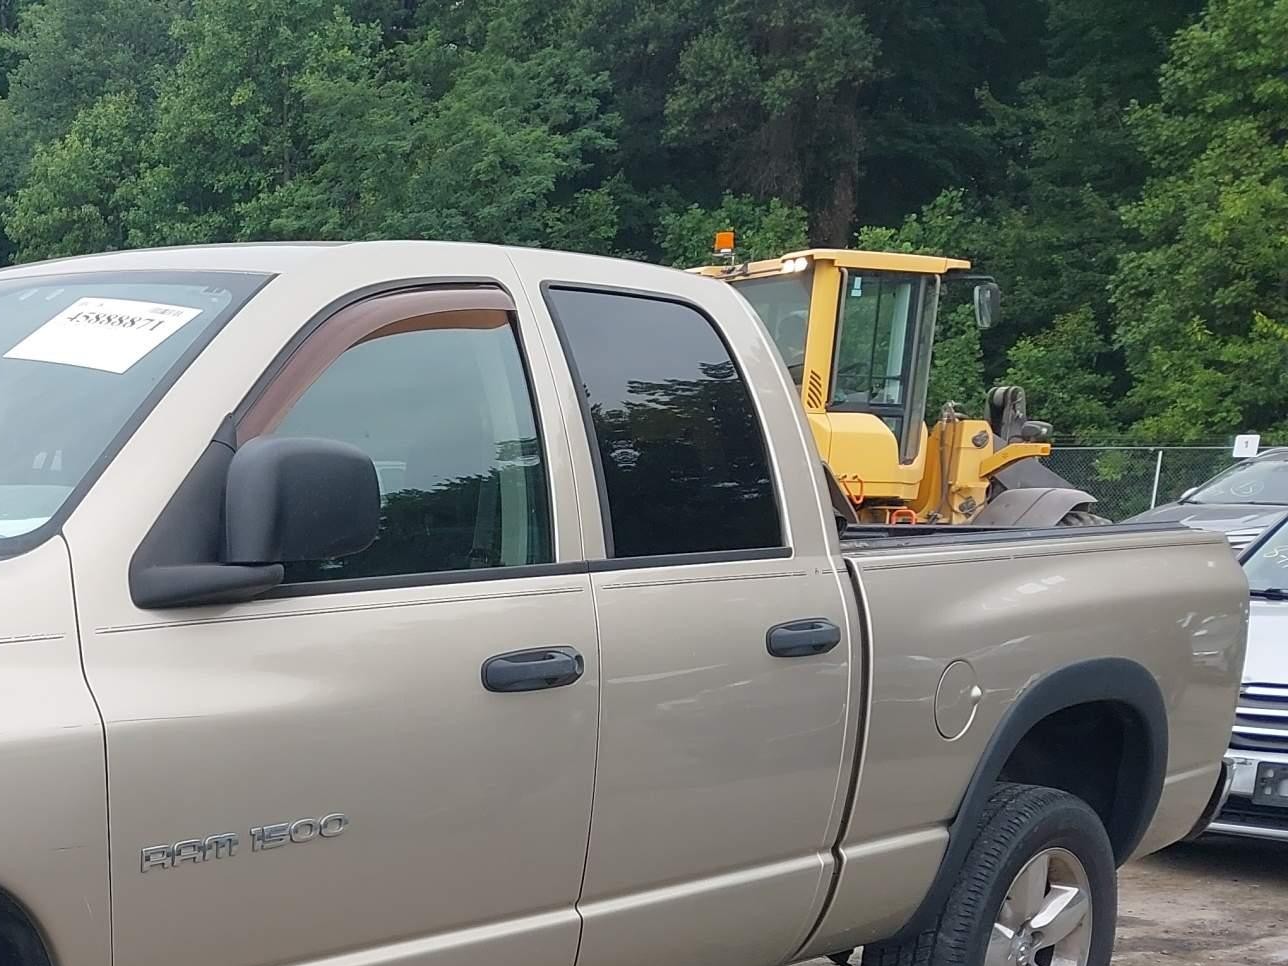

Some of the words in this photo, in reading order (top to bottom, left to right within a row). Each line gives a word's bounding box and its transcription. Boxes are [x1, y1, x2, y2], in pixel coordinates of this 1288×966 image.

[66, 311, 165, 331] 45888871
[140, 832, 241, 873] RAM
[249, 811, 349, 853] 1500
